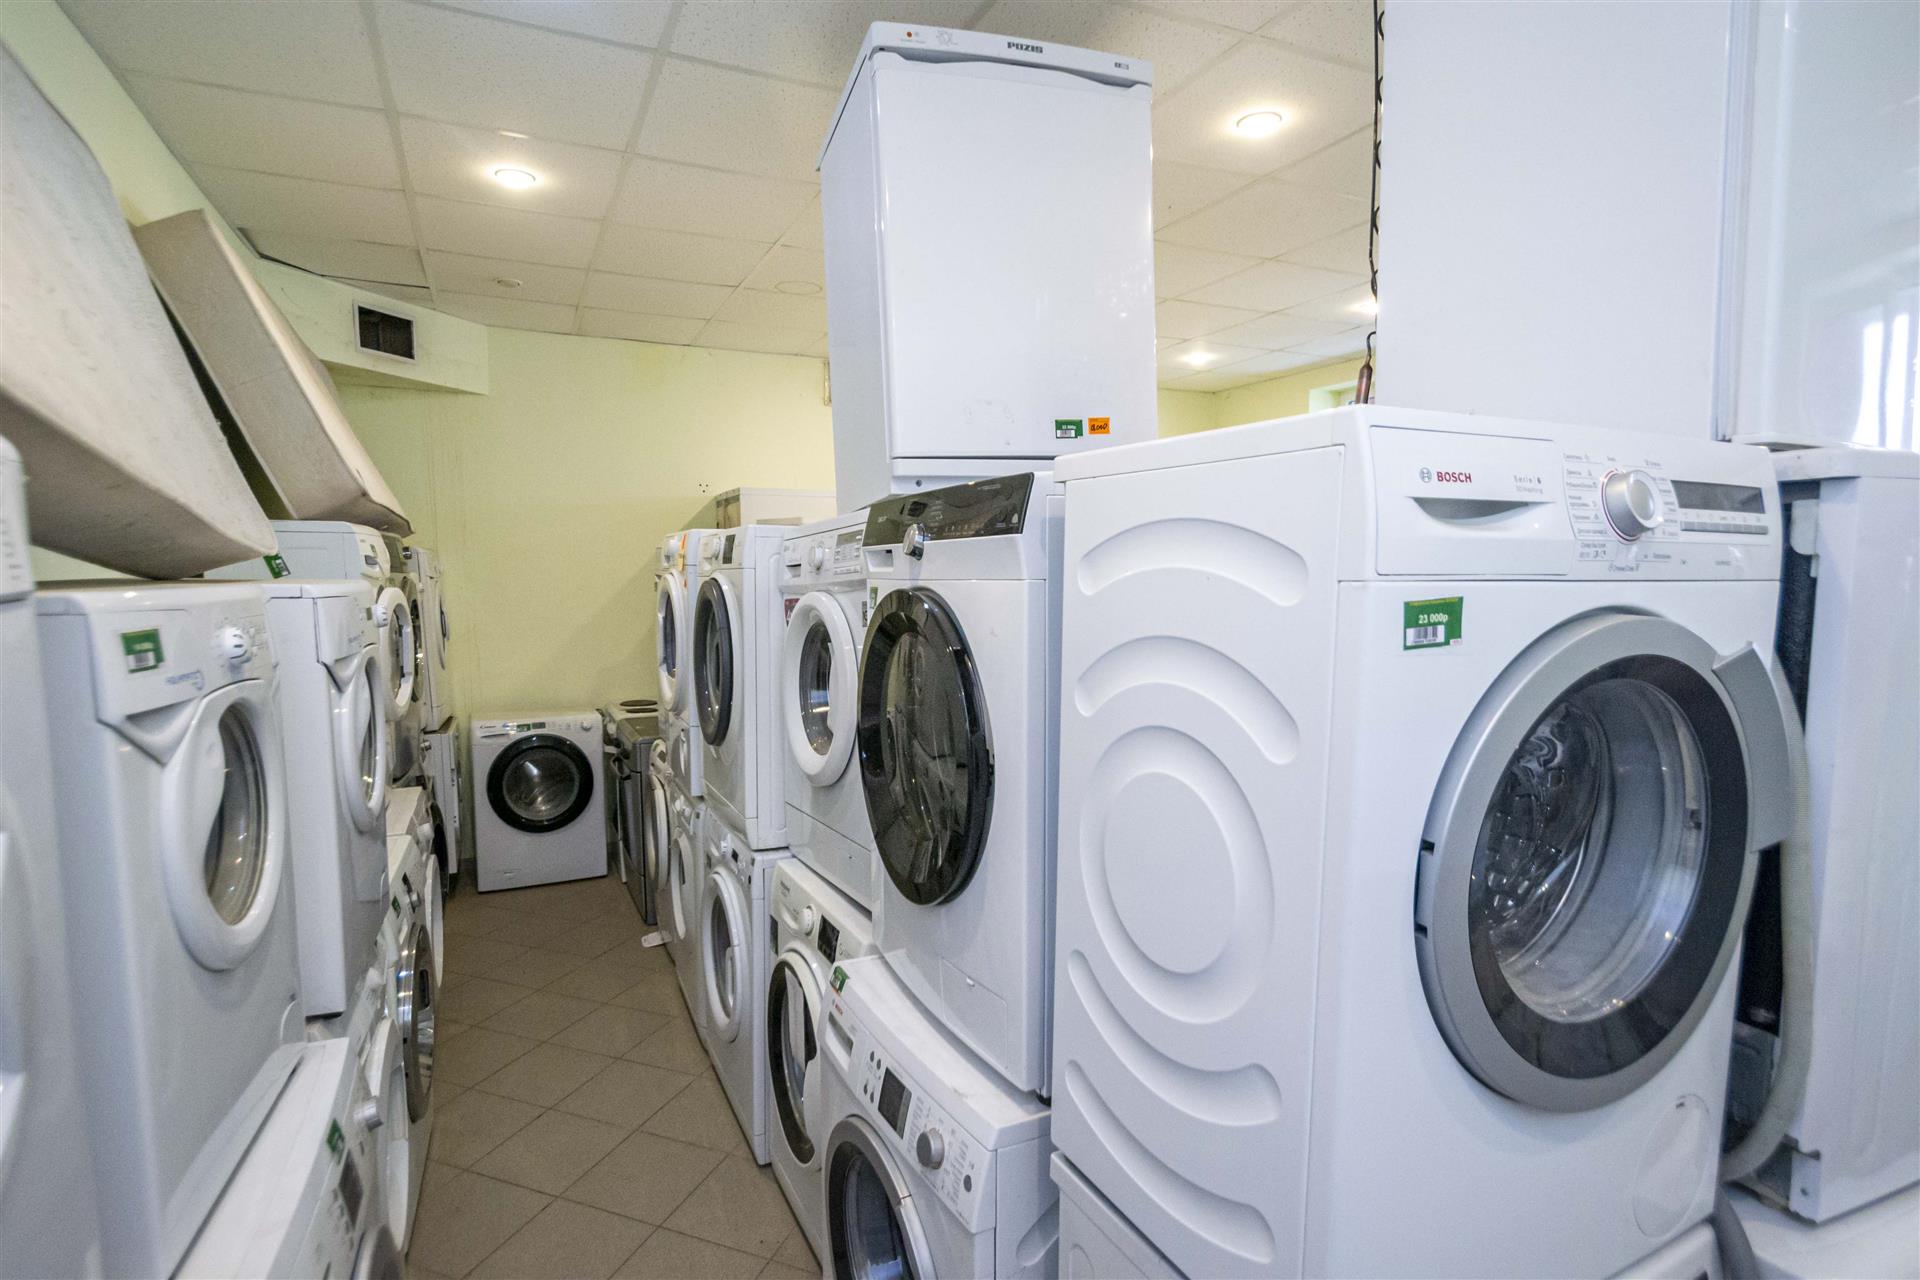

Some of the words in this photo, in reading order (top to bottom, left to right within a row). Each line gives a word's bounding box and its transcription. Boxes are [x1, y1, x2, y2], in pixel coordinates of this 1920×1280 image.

[1007, 42, 1043, 54] POZIS
[1436, 471, 1472, 483] BOSCH
[1418, 614, 1428, 624] 23
